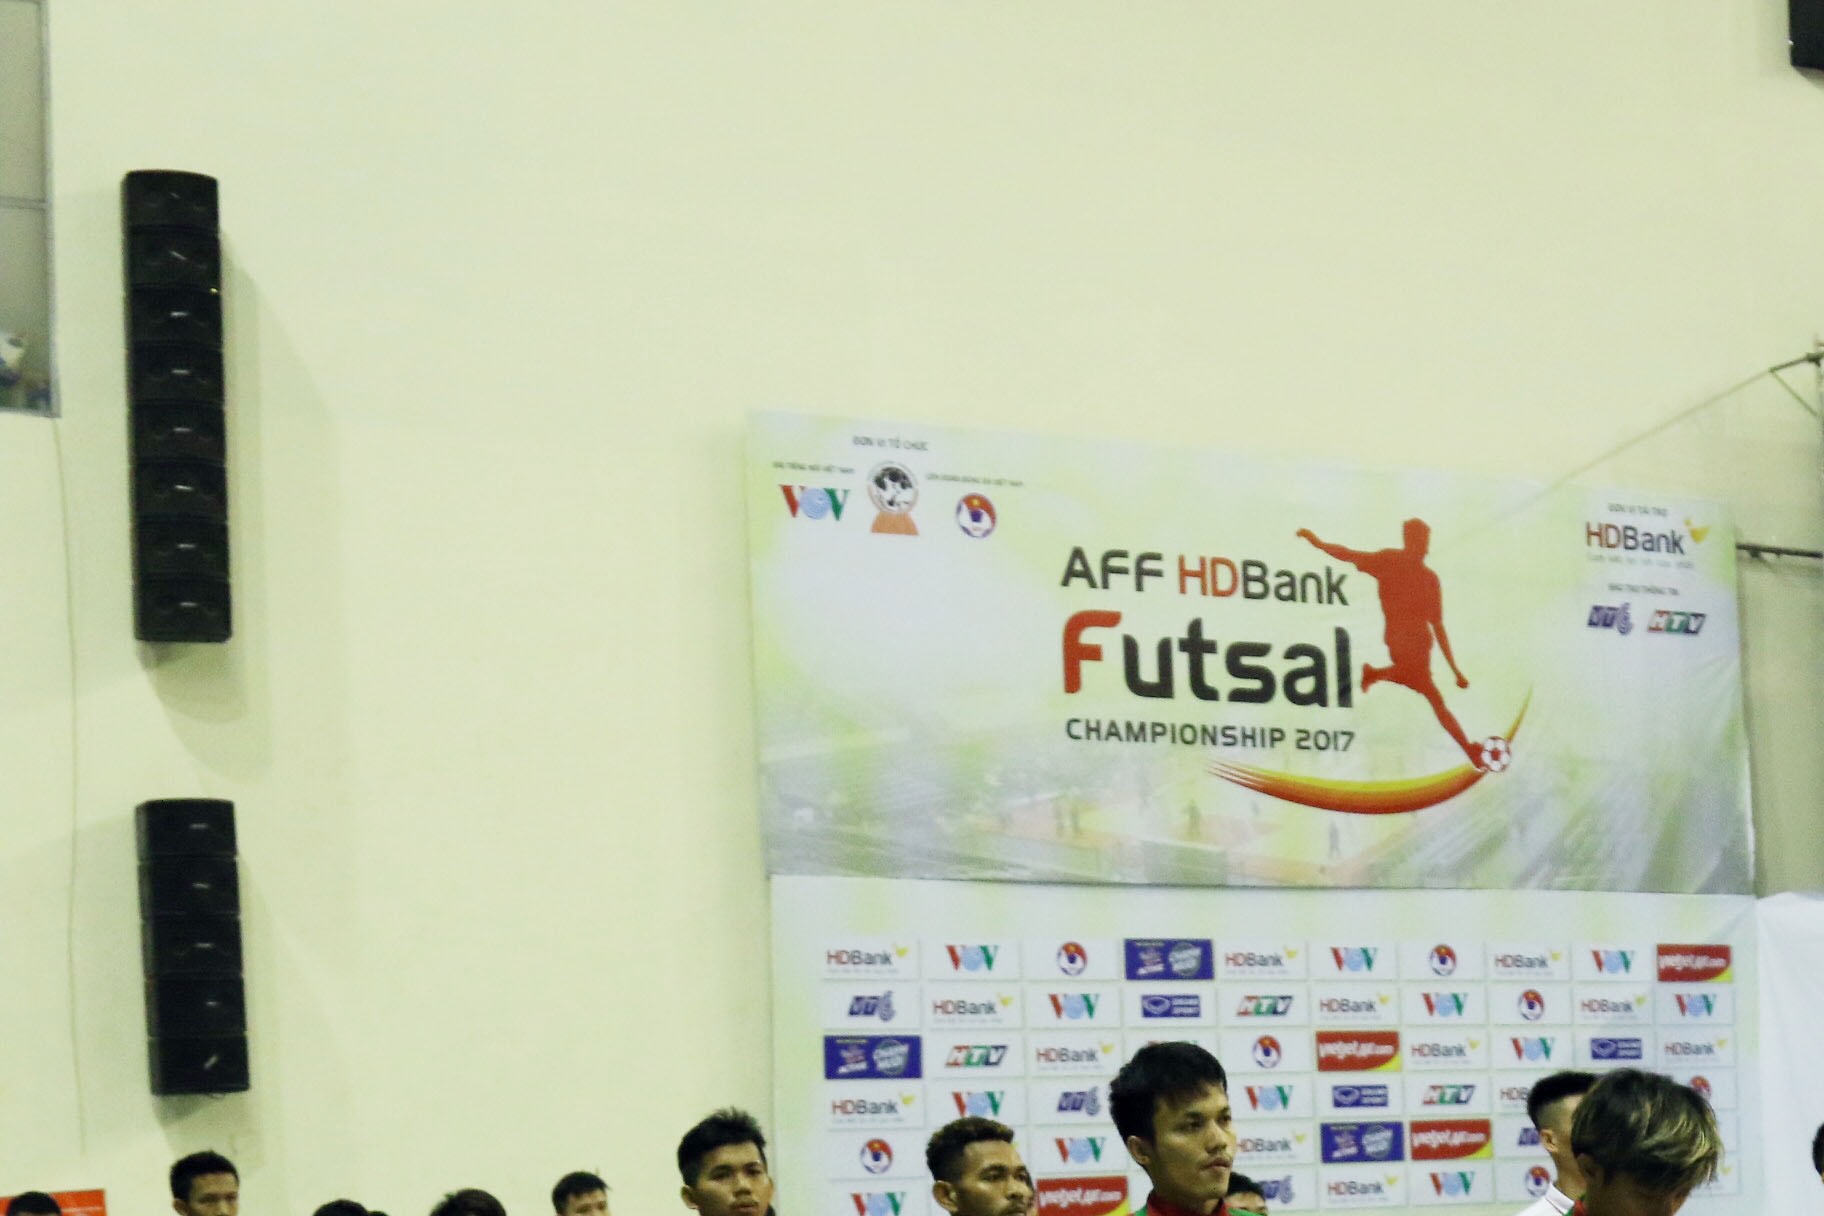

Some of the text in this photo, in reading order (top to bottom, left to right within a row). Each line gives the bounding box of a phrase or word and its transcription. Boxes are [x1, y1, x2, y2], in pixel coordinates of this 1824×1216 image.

[778, 484, 850, 521] VOV
[1585, 521, 1686, 555] HDBank
[1061, 546, 1350, 606] AFF HDBank
[1062, 609, 1353, 708] Futsal
[1066, 718, 1355, 751] CHAMPIONSHIP 2017
[827, 950, 892, 967] HDBank
[946, 944, 999, 972] VOV
[1225, 951, 1283, 968] HDBank
[1495, 955, 1549, 969] HDBank
[933, 999, 996, 1015] HDBank
[1048, 993, 1100, 1020] VOV
[1319, 999, 1376, 1014] HDBank
[1581, 999, 1634, 1014] HDBank
[1036, 1048, 1097, 1063] HDBank
[1411, 1044, 1466, 1058] HDBank
[1664, 1042, 1715, 1056] HDBank
[832, 1099, 898, 1115] HDBank
[1055, 1136, 1106, 1164] VOV
[1328, 1182, 1384, 1196] HDBank
